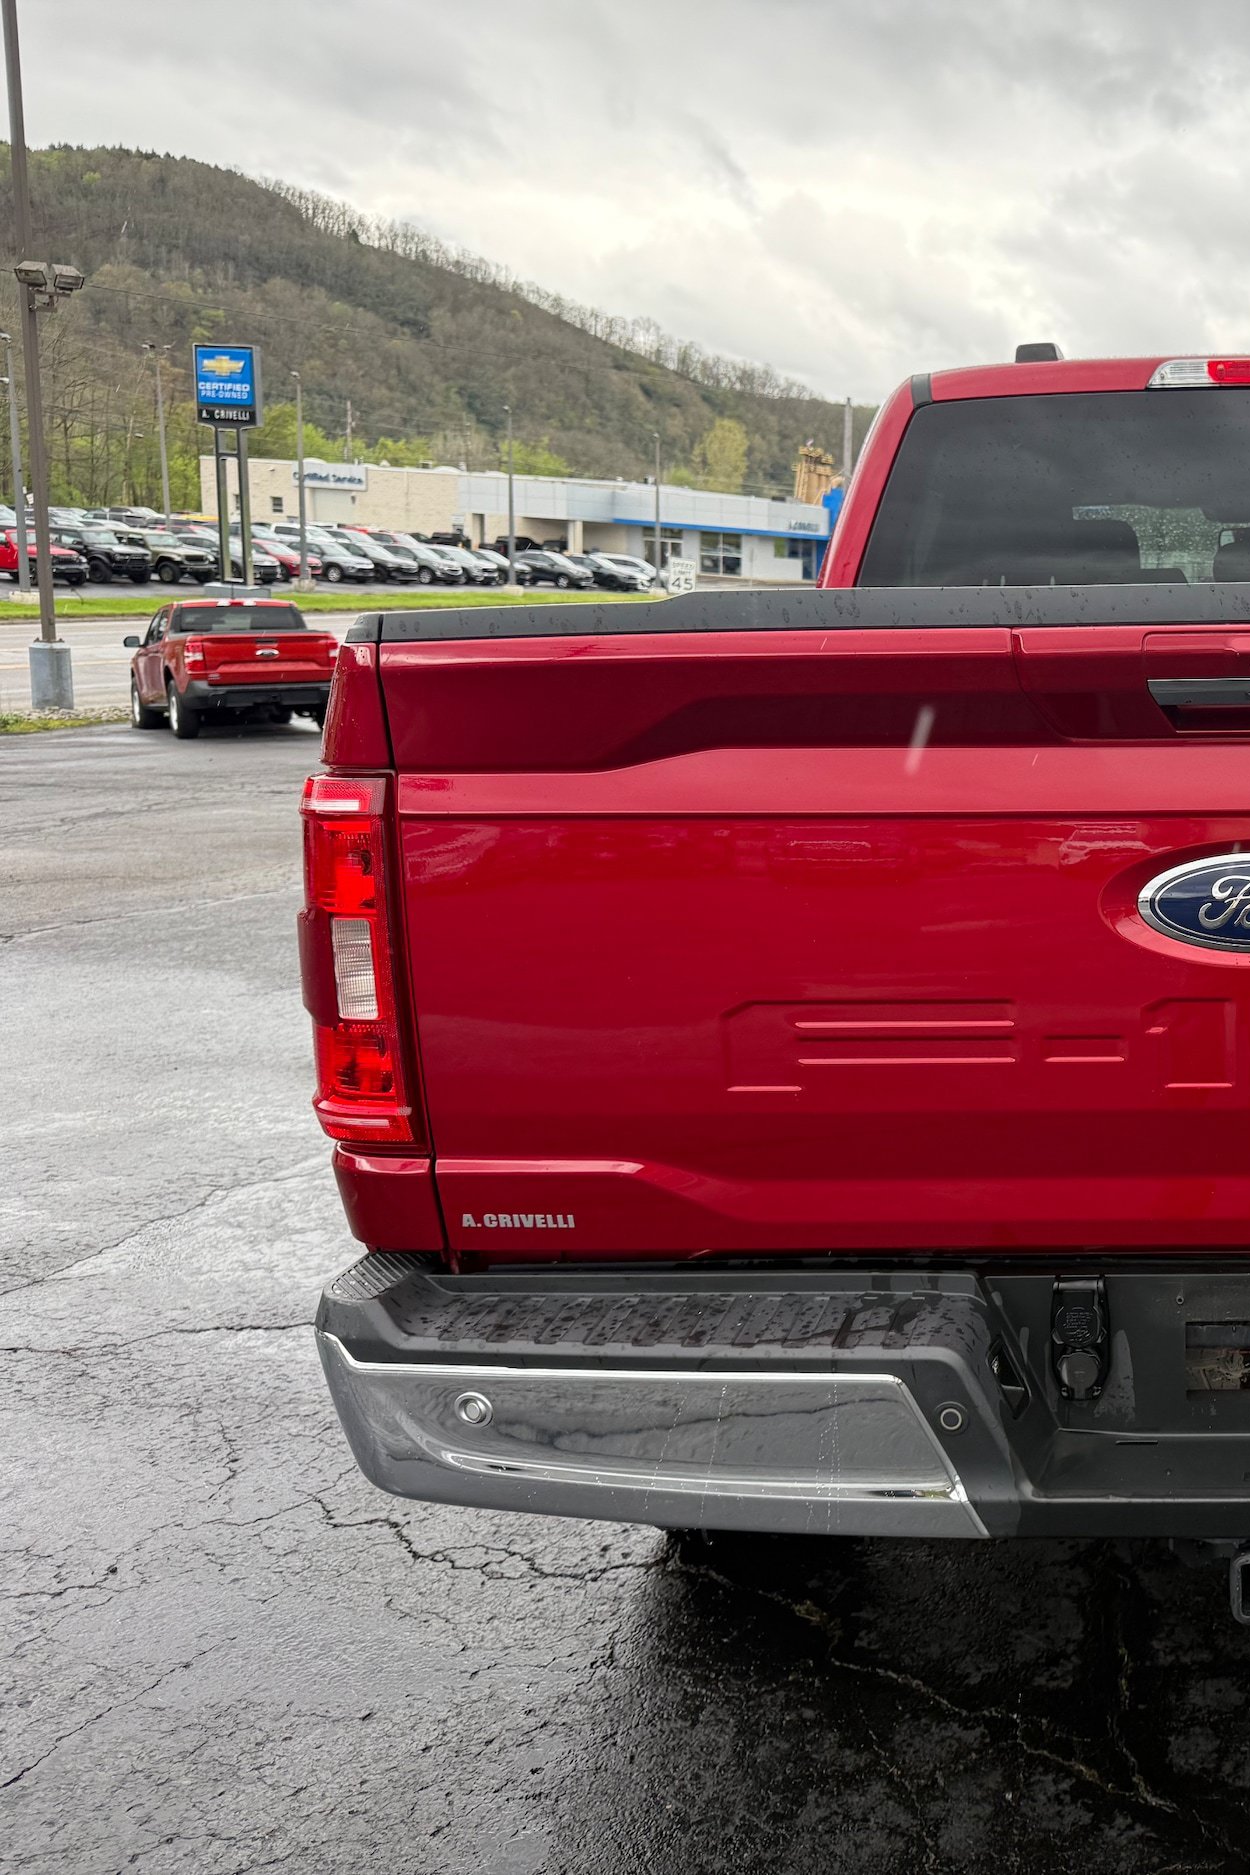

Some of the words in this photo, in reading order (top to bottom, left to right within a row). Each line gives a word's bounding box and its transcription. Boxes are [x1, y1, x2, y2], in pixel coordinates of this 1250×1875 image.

[198, 382, 250, 392] CERTIFIED
[201, 390, 248, 399] PRE-OWNED
[202, 409, 210, 418] A.
[214, 409, 250, 421] CRIVELLI
[293, 471, 330, 482] Crtified
[671, 576, 694, 591] 45
